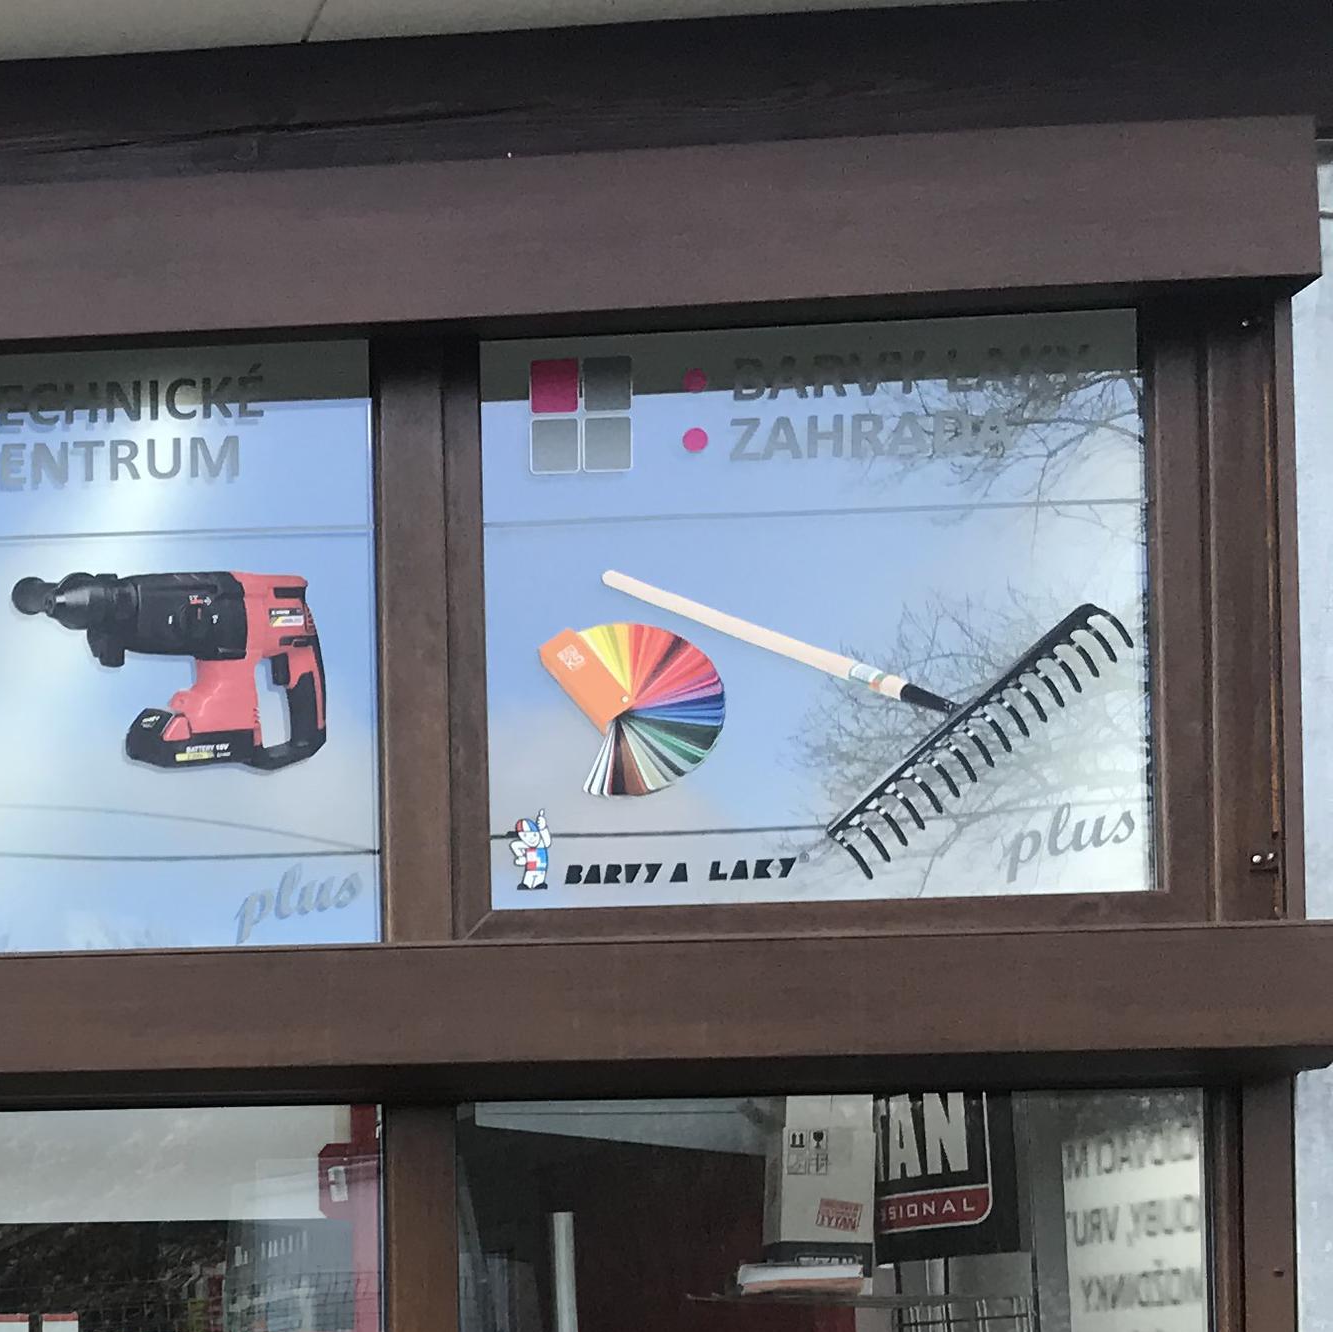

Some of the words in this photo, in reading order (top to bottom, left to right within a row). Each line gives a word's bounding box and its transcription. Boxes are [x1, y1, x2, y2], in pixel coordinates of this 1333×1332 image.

[729, 407, 1011, 461] ZAHRADA
[564, 862, 662, 885] BARVY
[669, 862, 689, 883] A
[708, 856, 797, 881] LAKY
[1005, 800, 1137, 883] plus
[233, 860, 364, 945] plus
